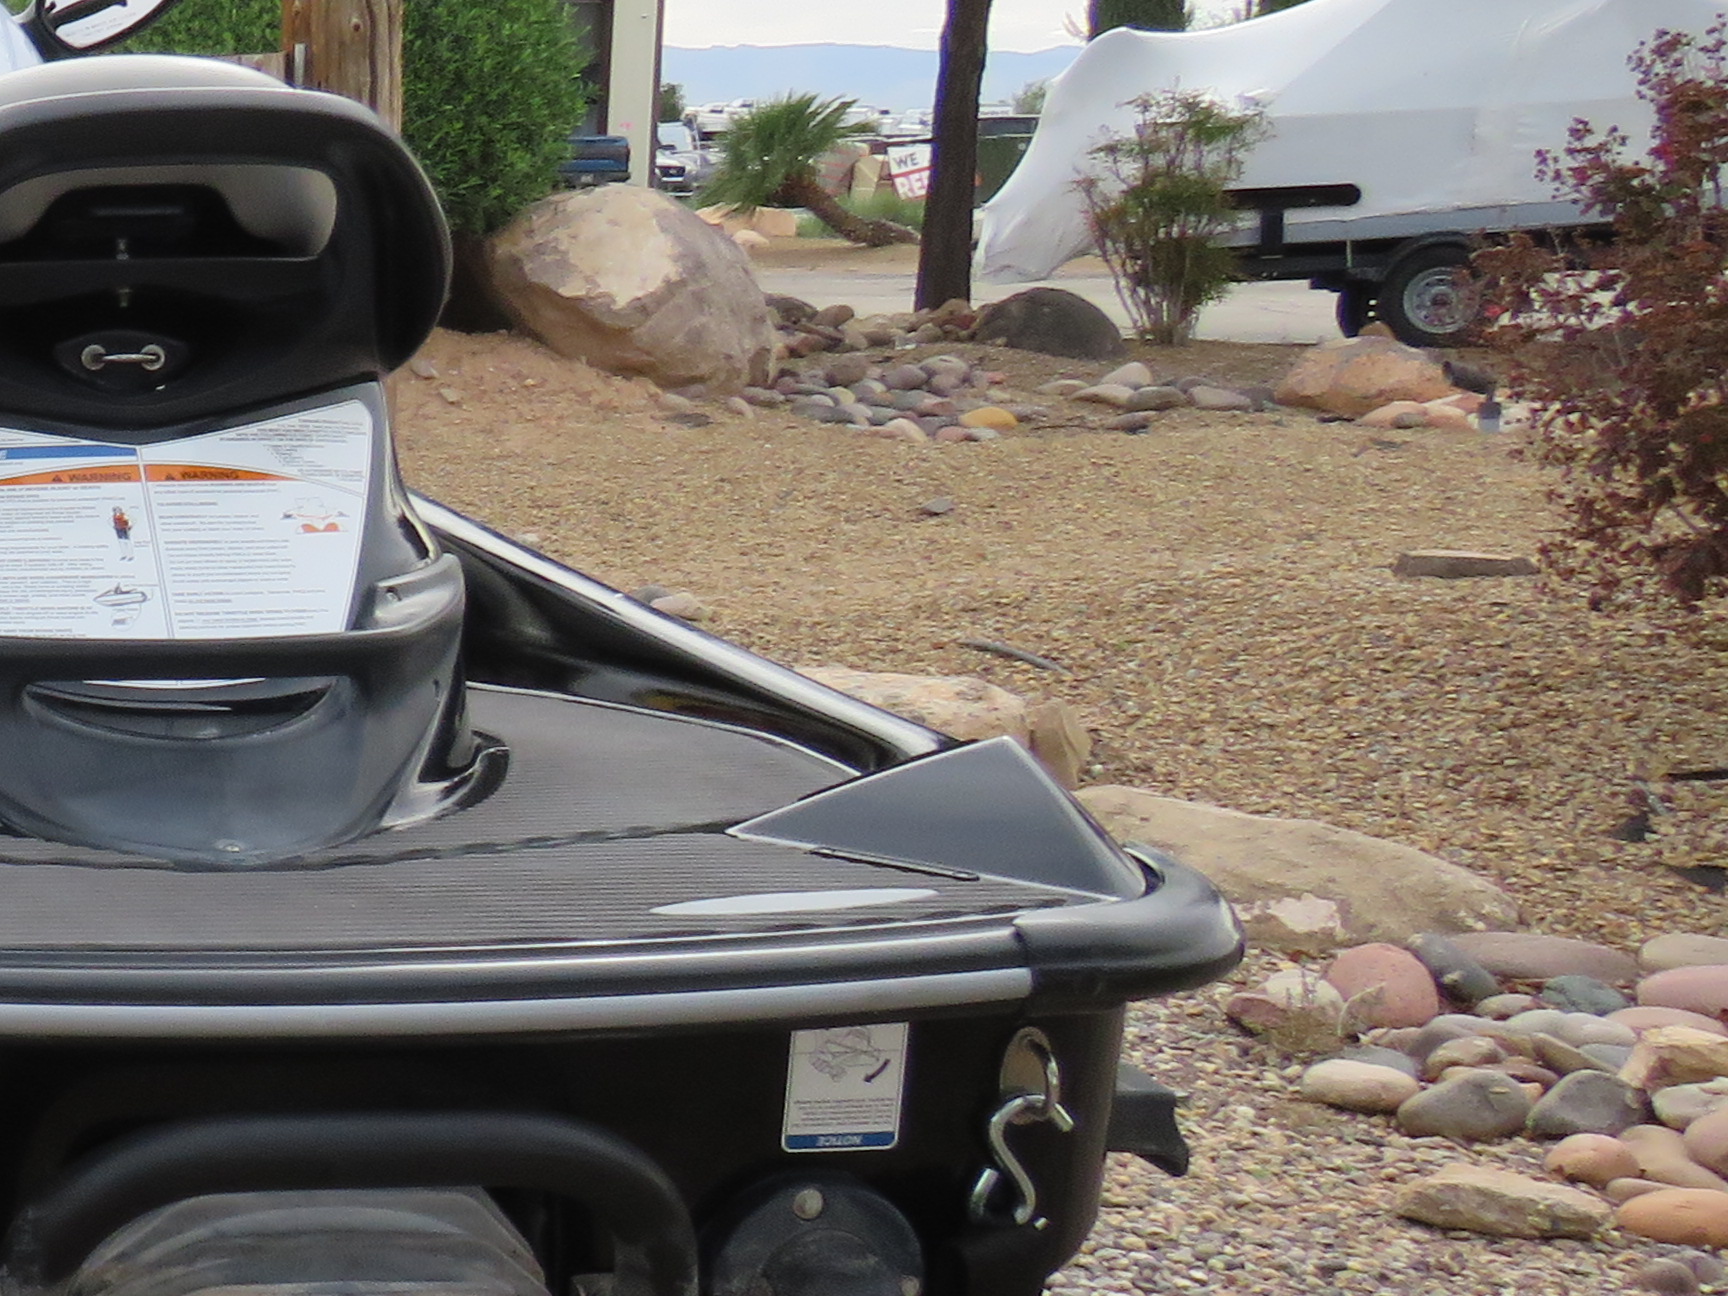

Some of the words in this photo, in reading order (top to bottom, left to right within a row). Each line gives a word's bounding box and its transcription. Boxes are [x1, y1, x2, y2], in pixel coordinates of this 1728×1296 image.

[892, 152, 919, 170] WE
[68, 471, 132, 482] WARNING
[180, 470, 240, 480] WARNING
[815, 1135, 864, 1147] NOTICE
